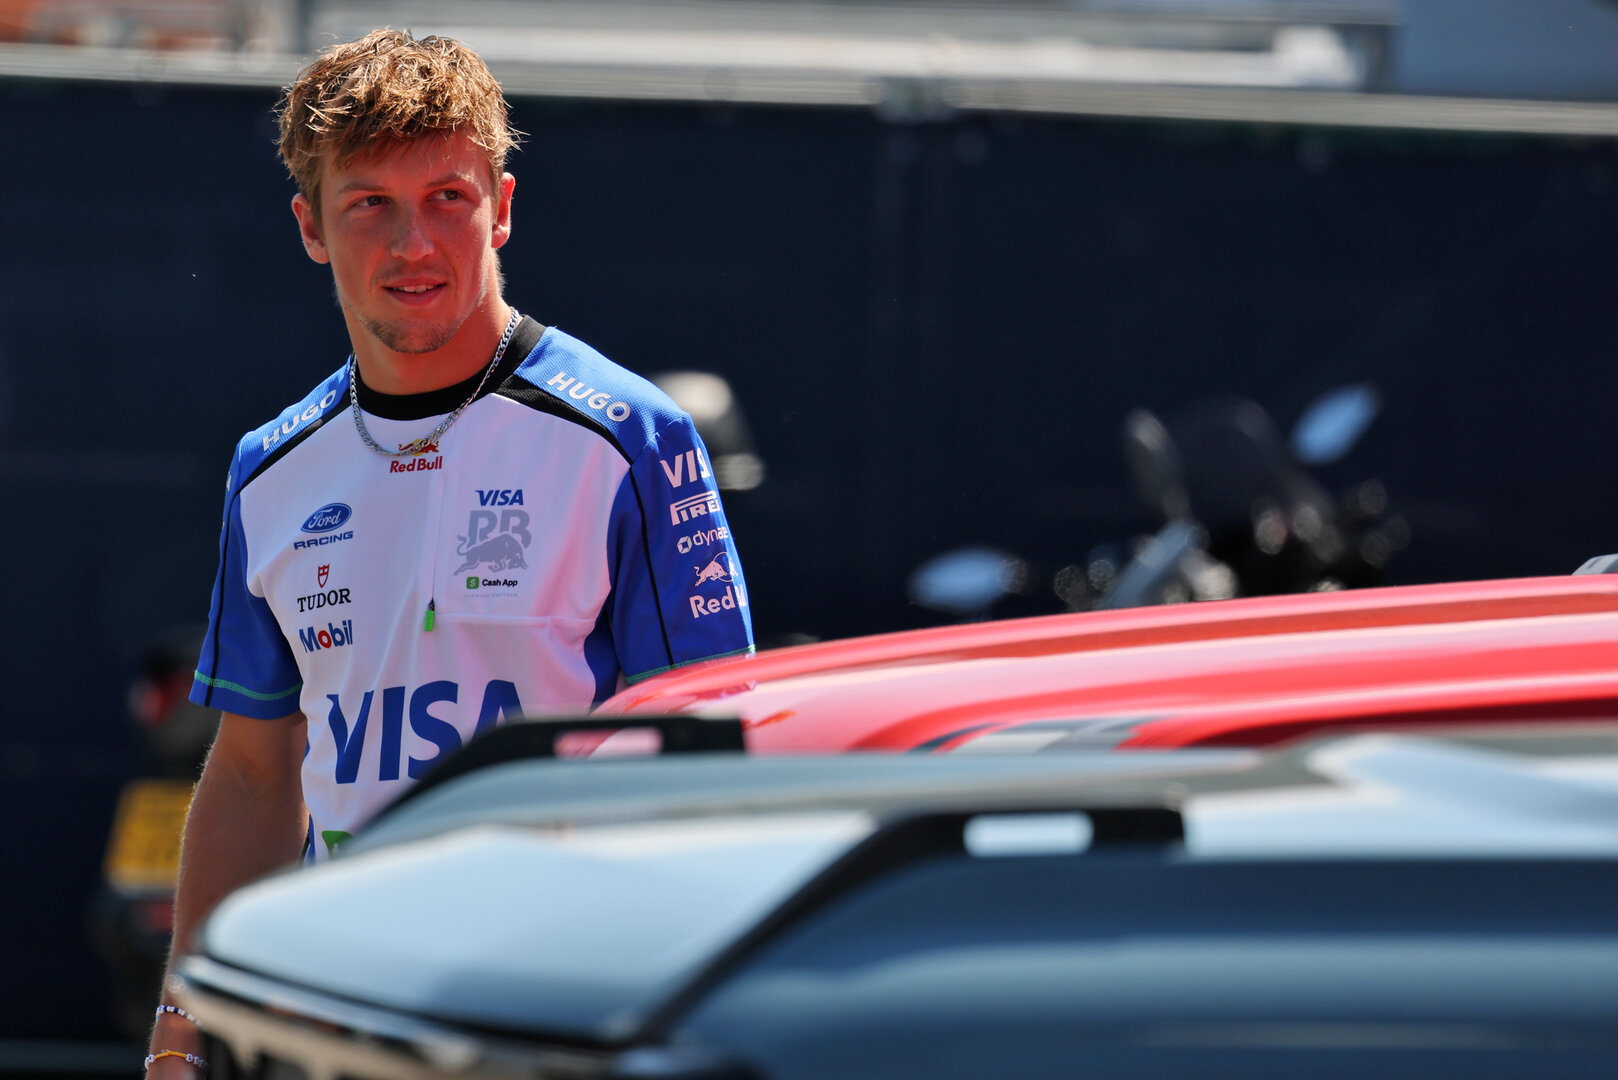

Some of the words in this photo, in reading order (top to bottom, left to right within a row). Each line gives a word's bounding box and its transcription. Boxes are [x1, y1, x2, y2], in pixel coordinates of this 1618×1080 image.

[546, 371, 631, 422] HUGO
[262, 389, 337, 452] HUGO
[389, 458, 416, 474] Red
[416, 455, 443, 471] Bull
[660, 447, 711, 488] VIS
[475, 489, 524, 507] VISA
[308, 508, 341, 529] Ford
[293, 530, 354, 550] RACING
[482, 579, 501, 587] Cash
[502, 579, 518, 588] App
[297, 588, 352, 613] TUDOR
[689, 585, 736, 619] Red
[299, 619, 354, 653] Mobil
